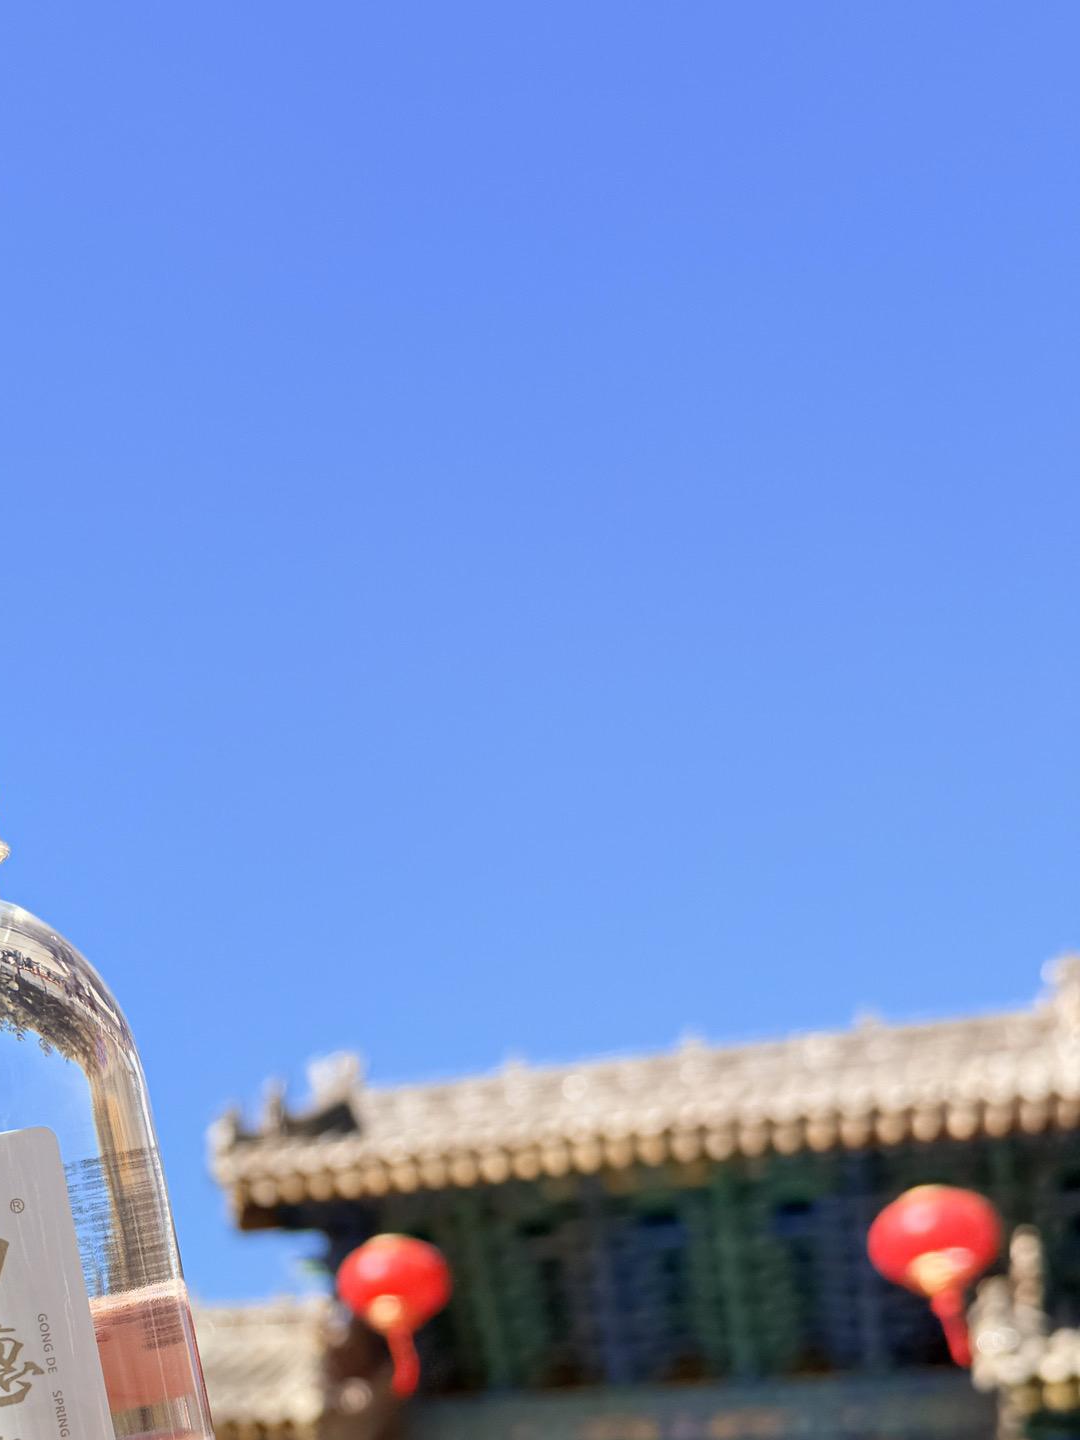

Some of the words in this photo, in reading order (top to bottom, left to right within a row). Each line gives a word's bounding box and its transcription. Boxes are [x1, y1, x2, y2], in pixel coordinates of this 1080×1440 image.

[37, 1313, 54, 1353] GONG
[45, 1357, 58, 1374] DE
[52, 1390, 70, 1438] SPRING
